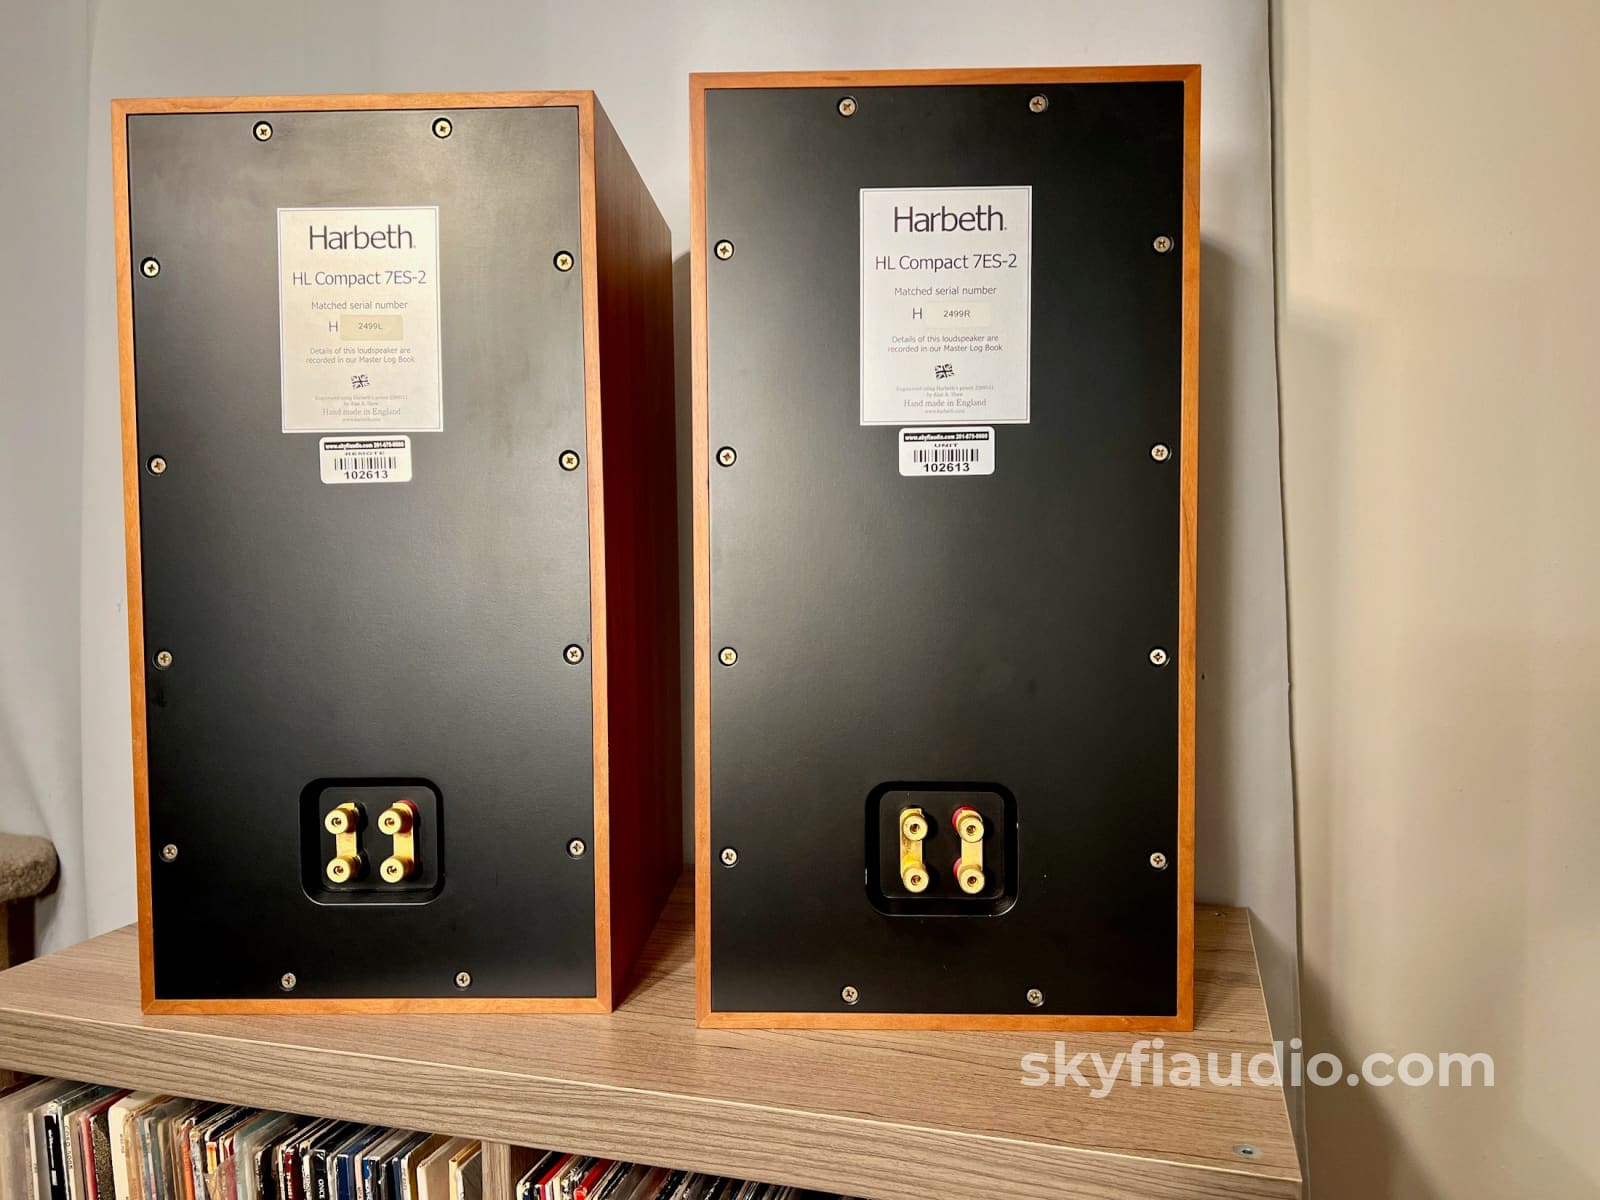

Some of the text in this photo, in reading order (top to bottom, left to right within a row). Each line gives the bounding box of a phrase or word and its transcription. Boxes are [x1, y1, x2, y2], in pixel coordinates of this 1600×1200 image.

[876, 253, 1018, 272] HL Compact 7ES-2
[293, 270, 426, 288] HL Compact 7ES-2
[894, 286, 997, 296] Matched serial number
[311, 300, 408, 310] Matched serial number
[912, 307, 971, 319] H 2499R
[328, 320, 383, 332] H 2499L
[892, 336, 916, 344] Details
[917, 335, 925, 343] of
[942, 334, 985, 343] loudspeaker
[310, 347, 333, 355] Details
[334, 347, 341, 355] of
[357, 346, 397, 355] loudspeaker
[888, 345, 919, 353] recorded
[943, 344, 967, 352] Master
[969, 344, 983, 353] Log
[306, 356, 336, 364] recorded
[337, 356, 344, 364] in
[383, 356, 396, 365] Log
[904, 398, 986, 408] Hand made in England
[322, 408, 401, 417] Hand made in England
[924, 463, 970, 472] 102613
[344, 470, 388, 480] 102613
